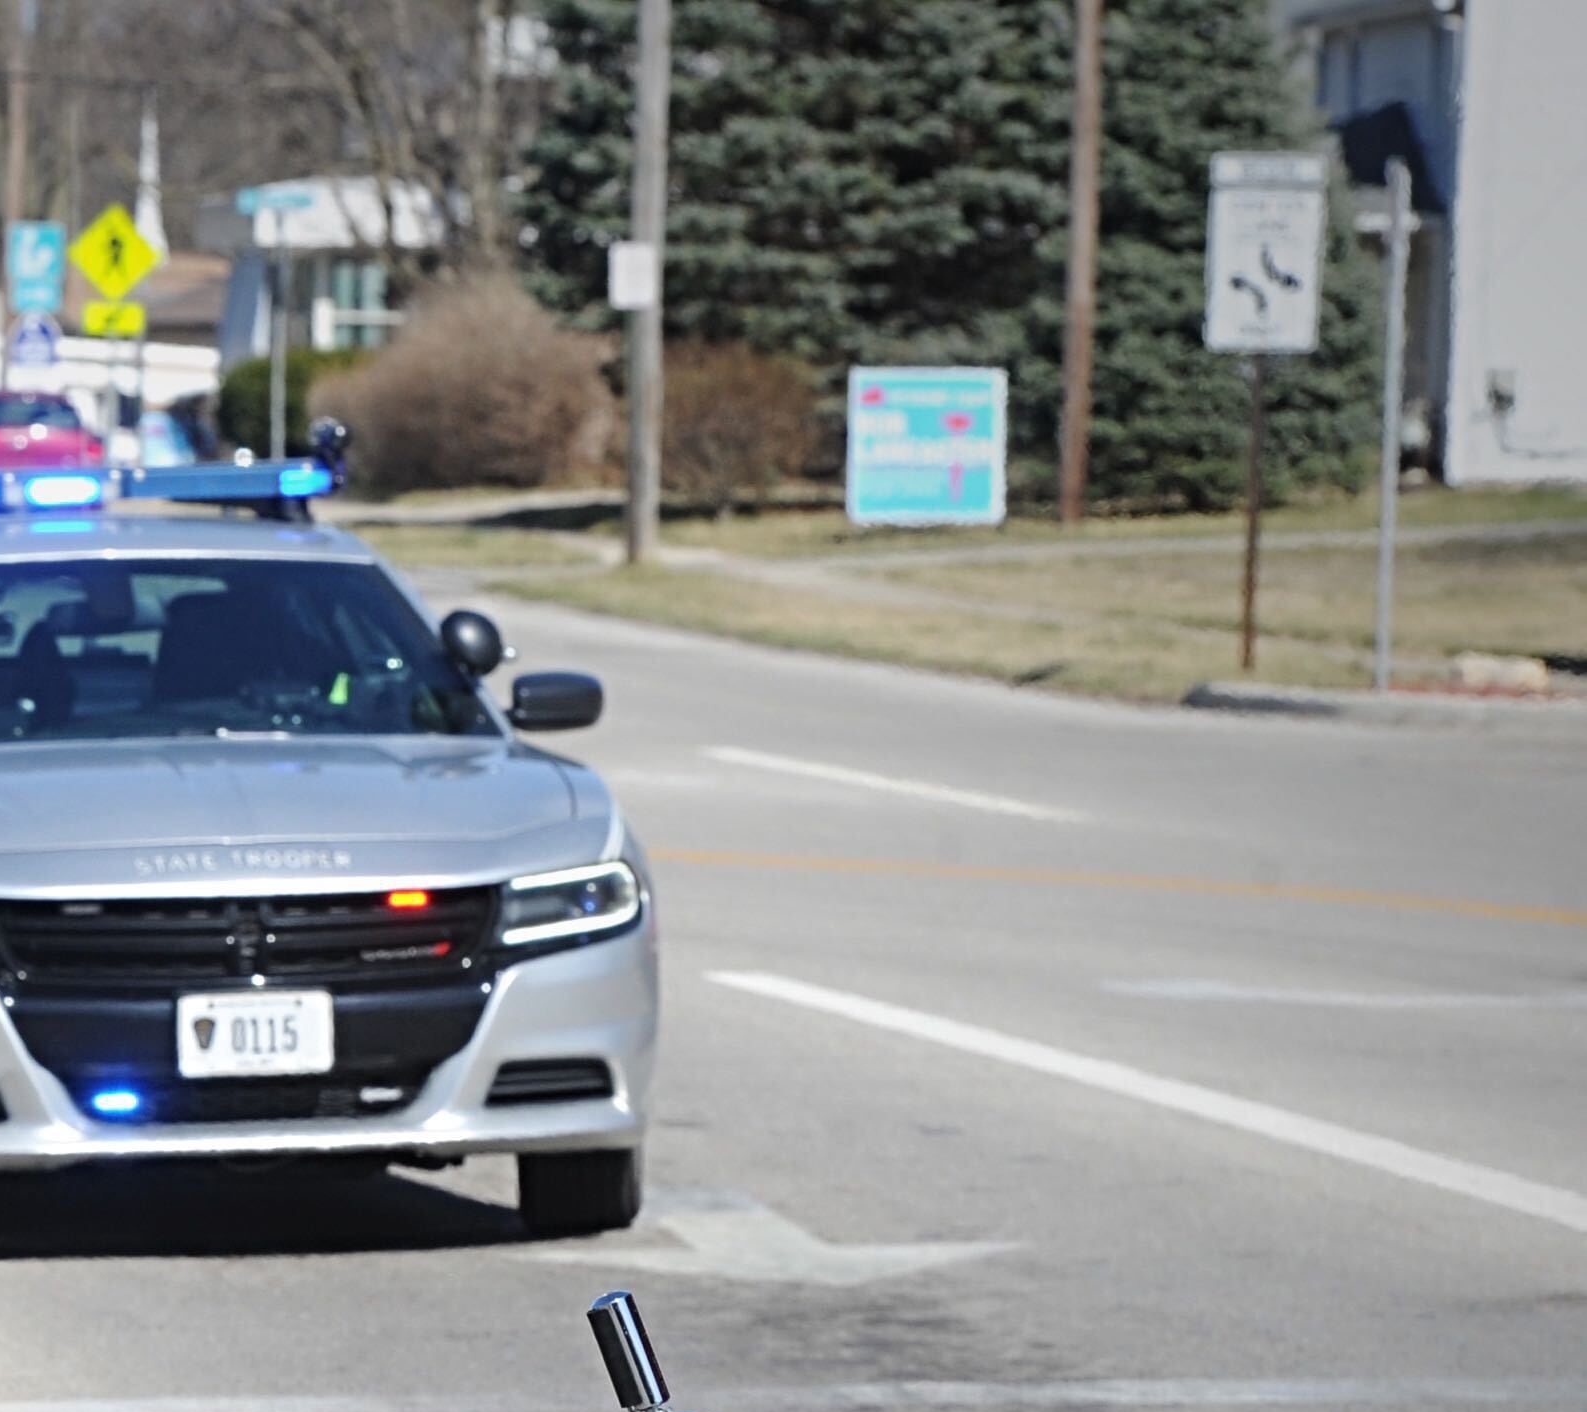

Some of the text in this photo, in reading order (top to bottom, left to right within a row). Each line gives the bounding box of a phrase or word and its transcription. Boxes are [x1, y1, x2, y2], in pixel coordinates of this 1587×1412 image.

[133, 849, 351, 876] STATE TROOPER
[232, 1016, 298, 1054] 0115
